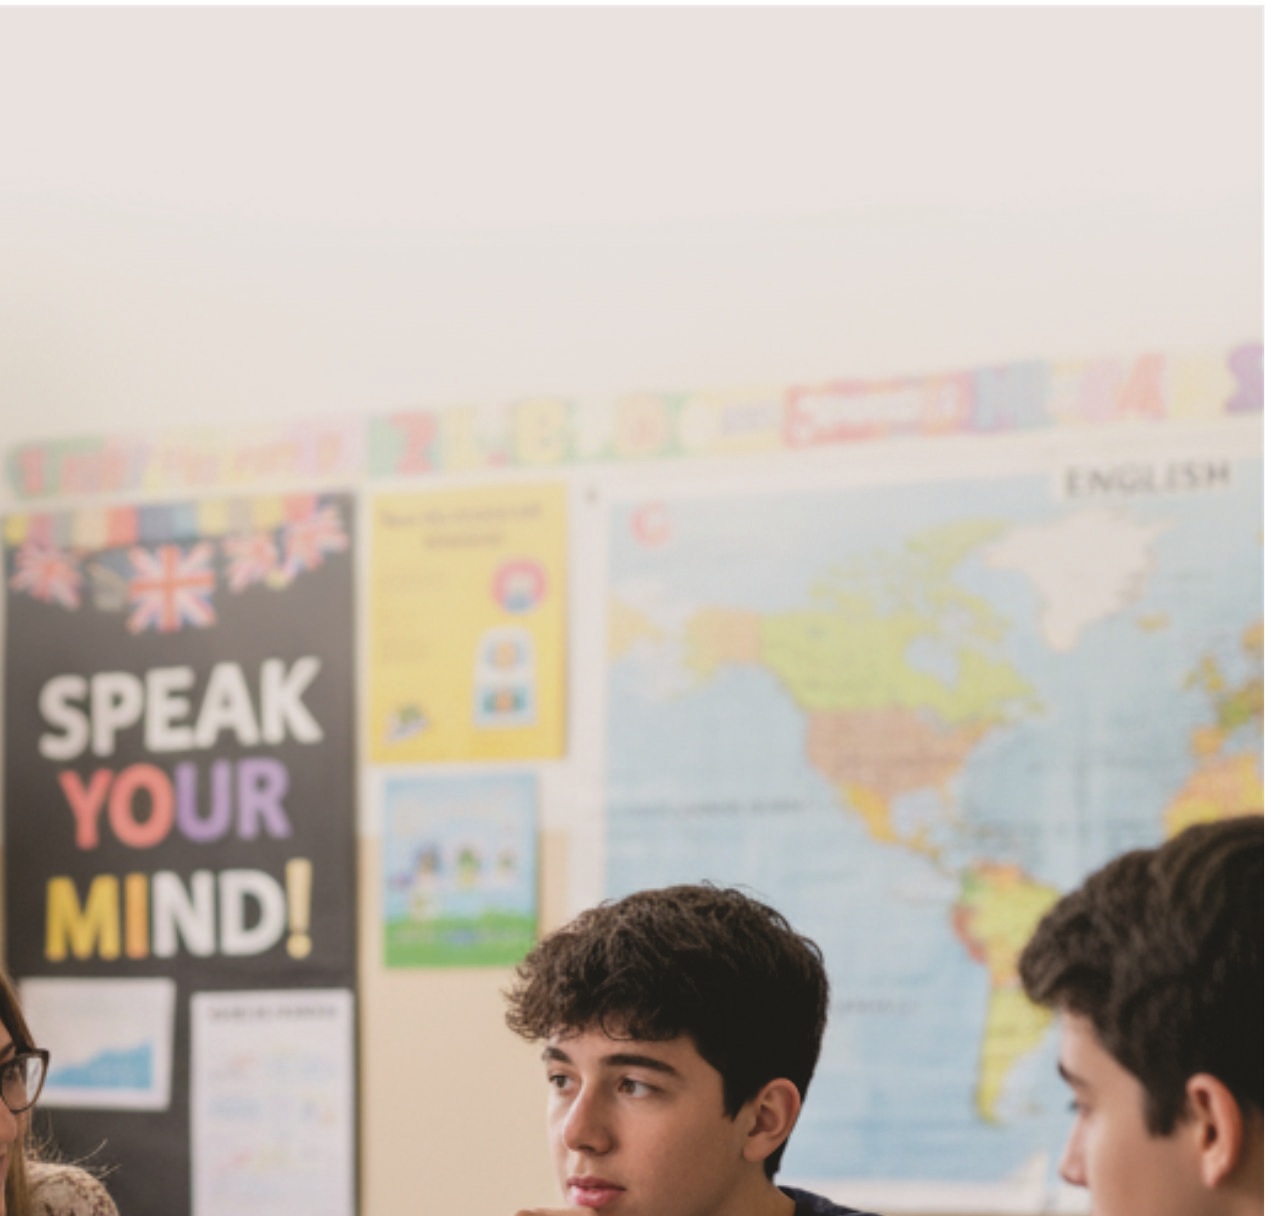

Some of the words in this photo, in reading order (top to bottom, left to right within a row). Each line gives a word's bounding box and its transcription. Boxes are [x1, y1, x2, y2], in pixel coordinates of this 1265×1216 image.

[1064, 460, 1232, 498] ENGLISH
[39, 656, 323, 761] SPEAK
[58, 756, 291, 850] YOUR
[45, 858, 313, 960] MIND!
